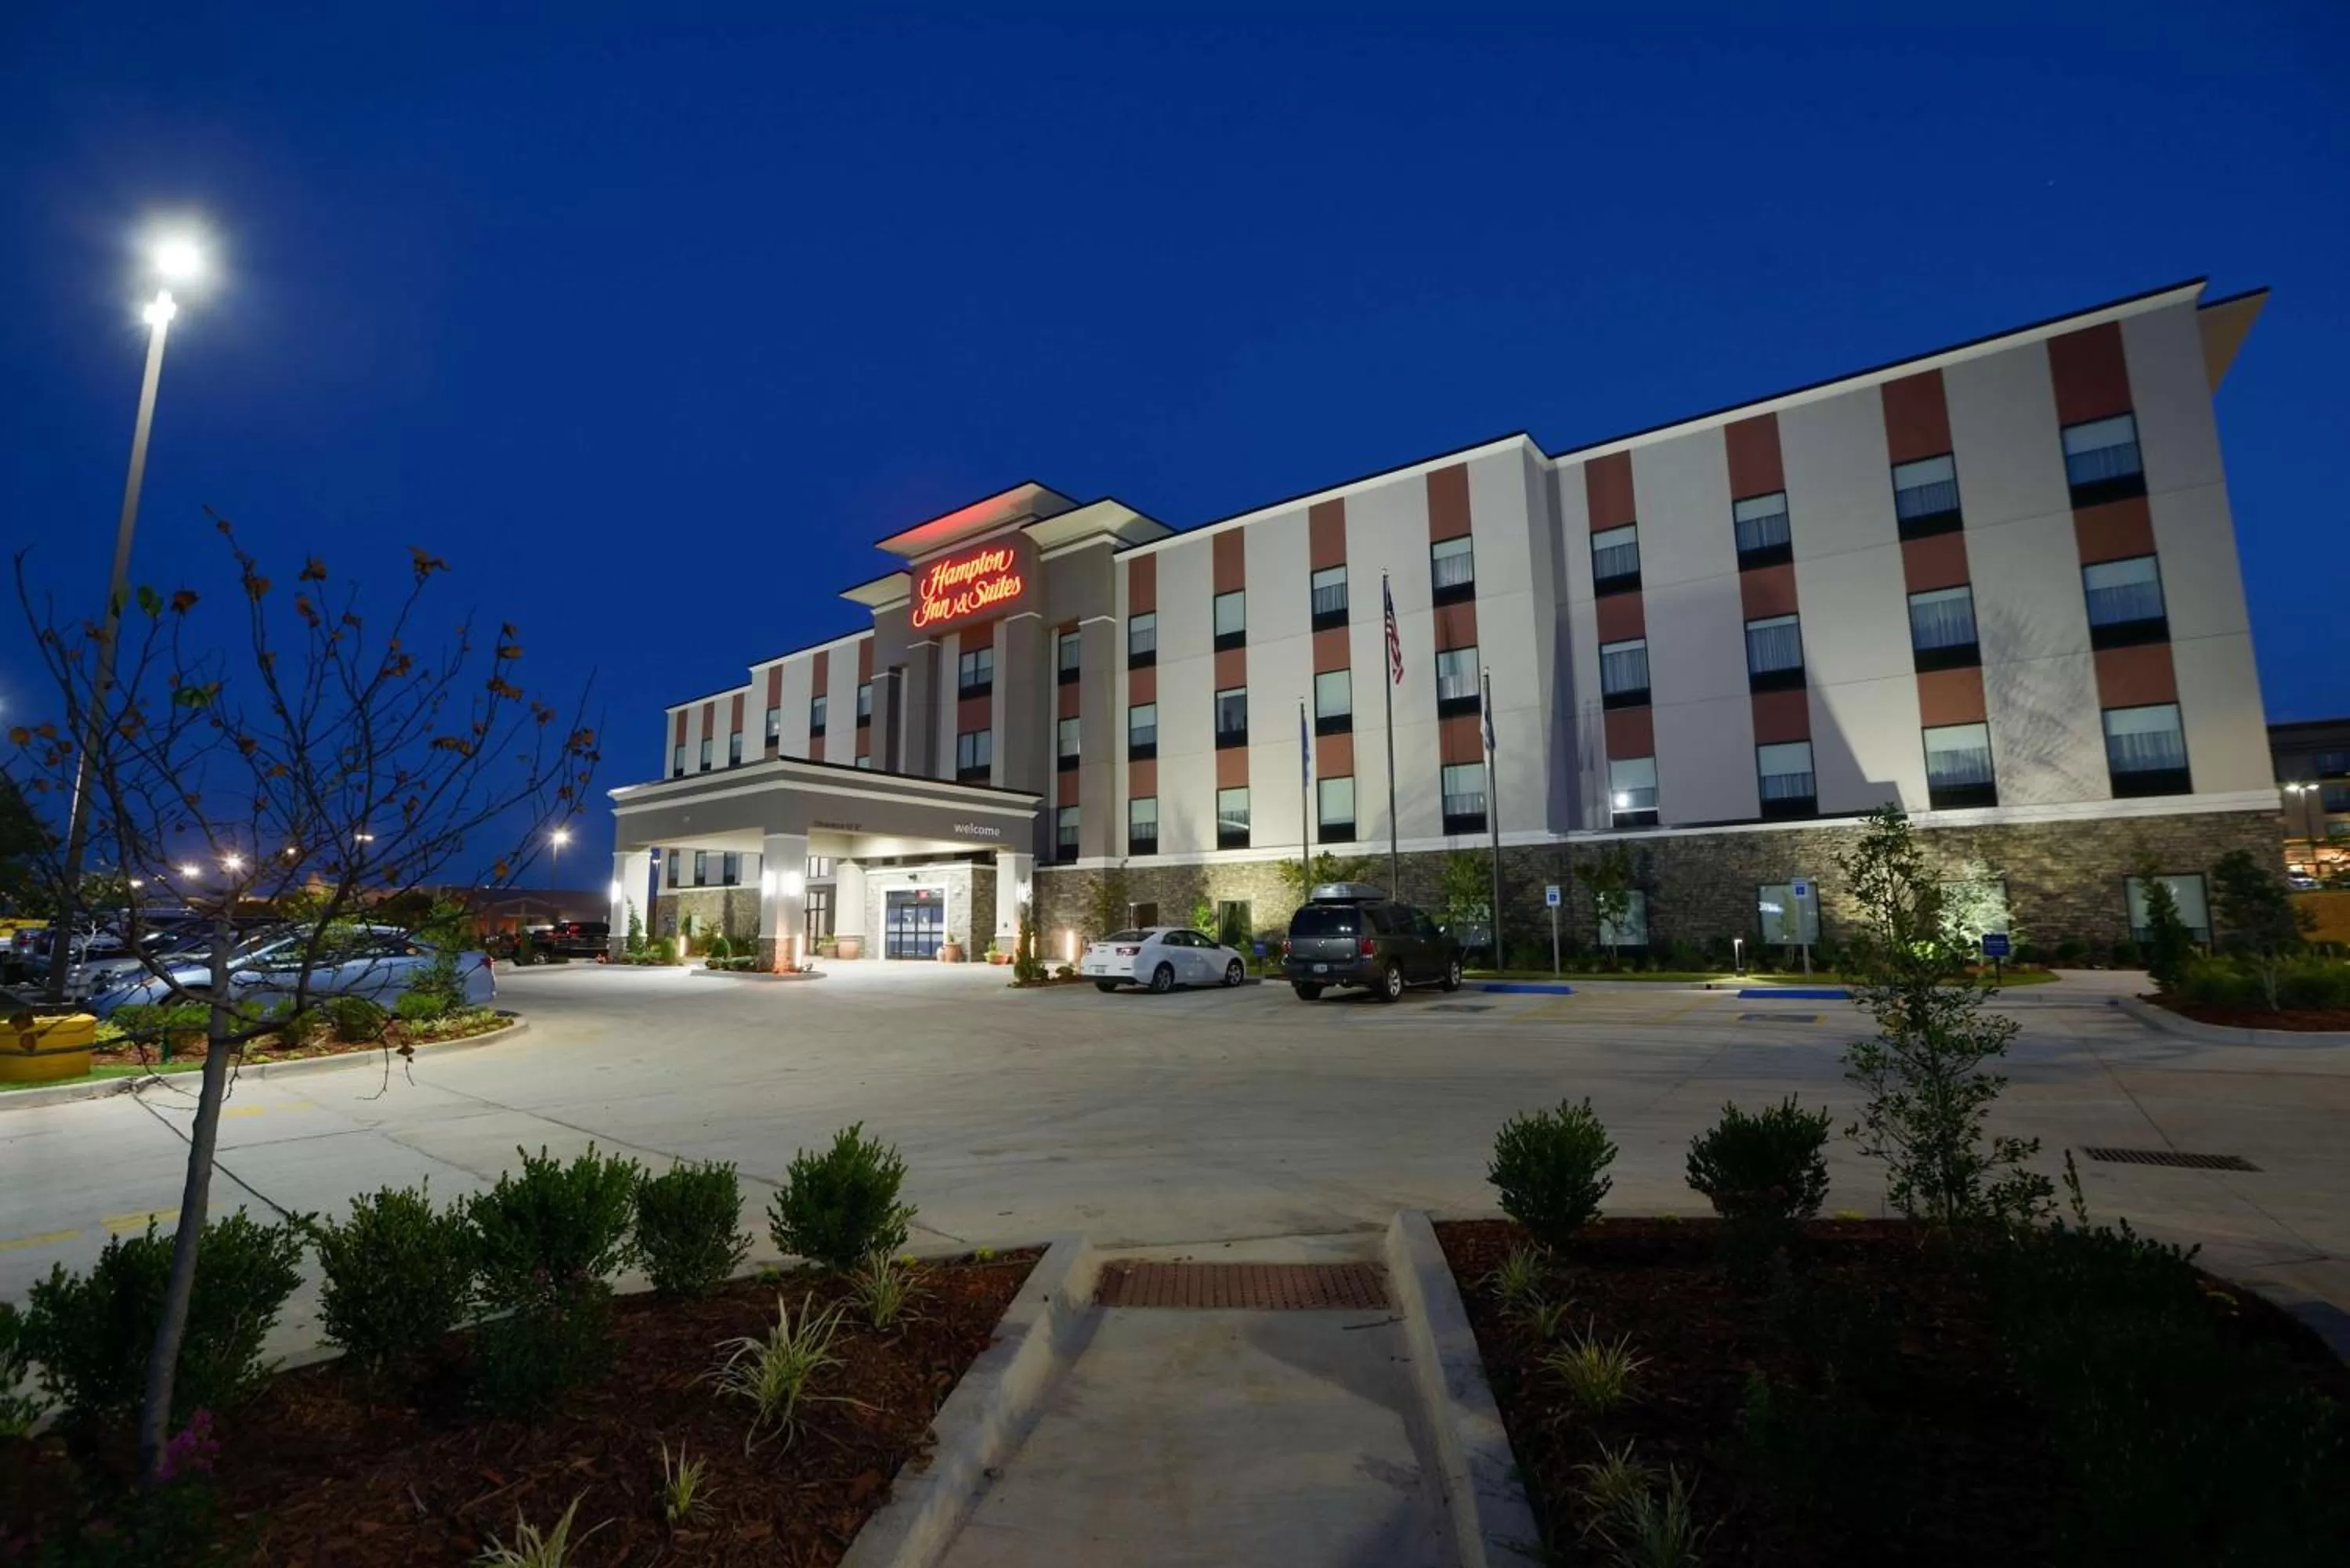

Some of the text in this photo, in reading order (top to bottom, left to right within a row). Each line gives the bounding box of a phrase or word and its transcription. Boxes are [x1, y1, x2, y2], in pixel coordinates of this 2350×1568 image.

[920, 549, 1014, 600] Hampton
[913, 575, 1021, 627] Inn & Suites
[953, 822, 1000, 836] welcome
